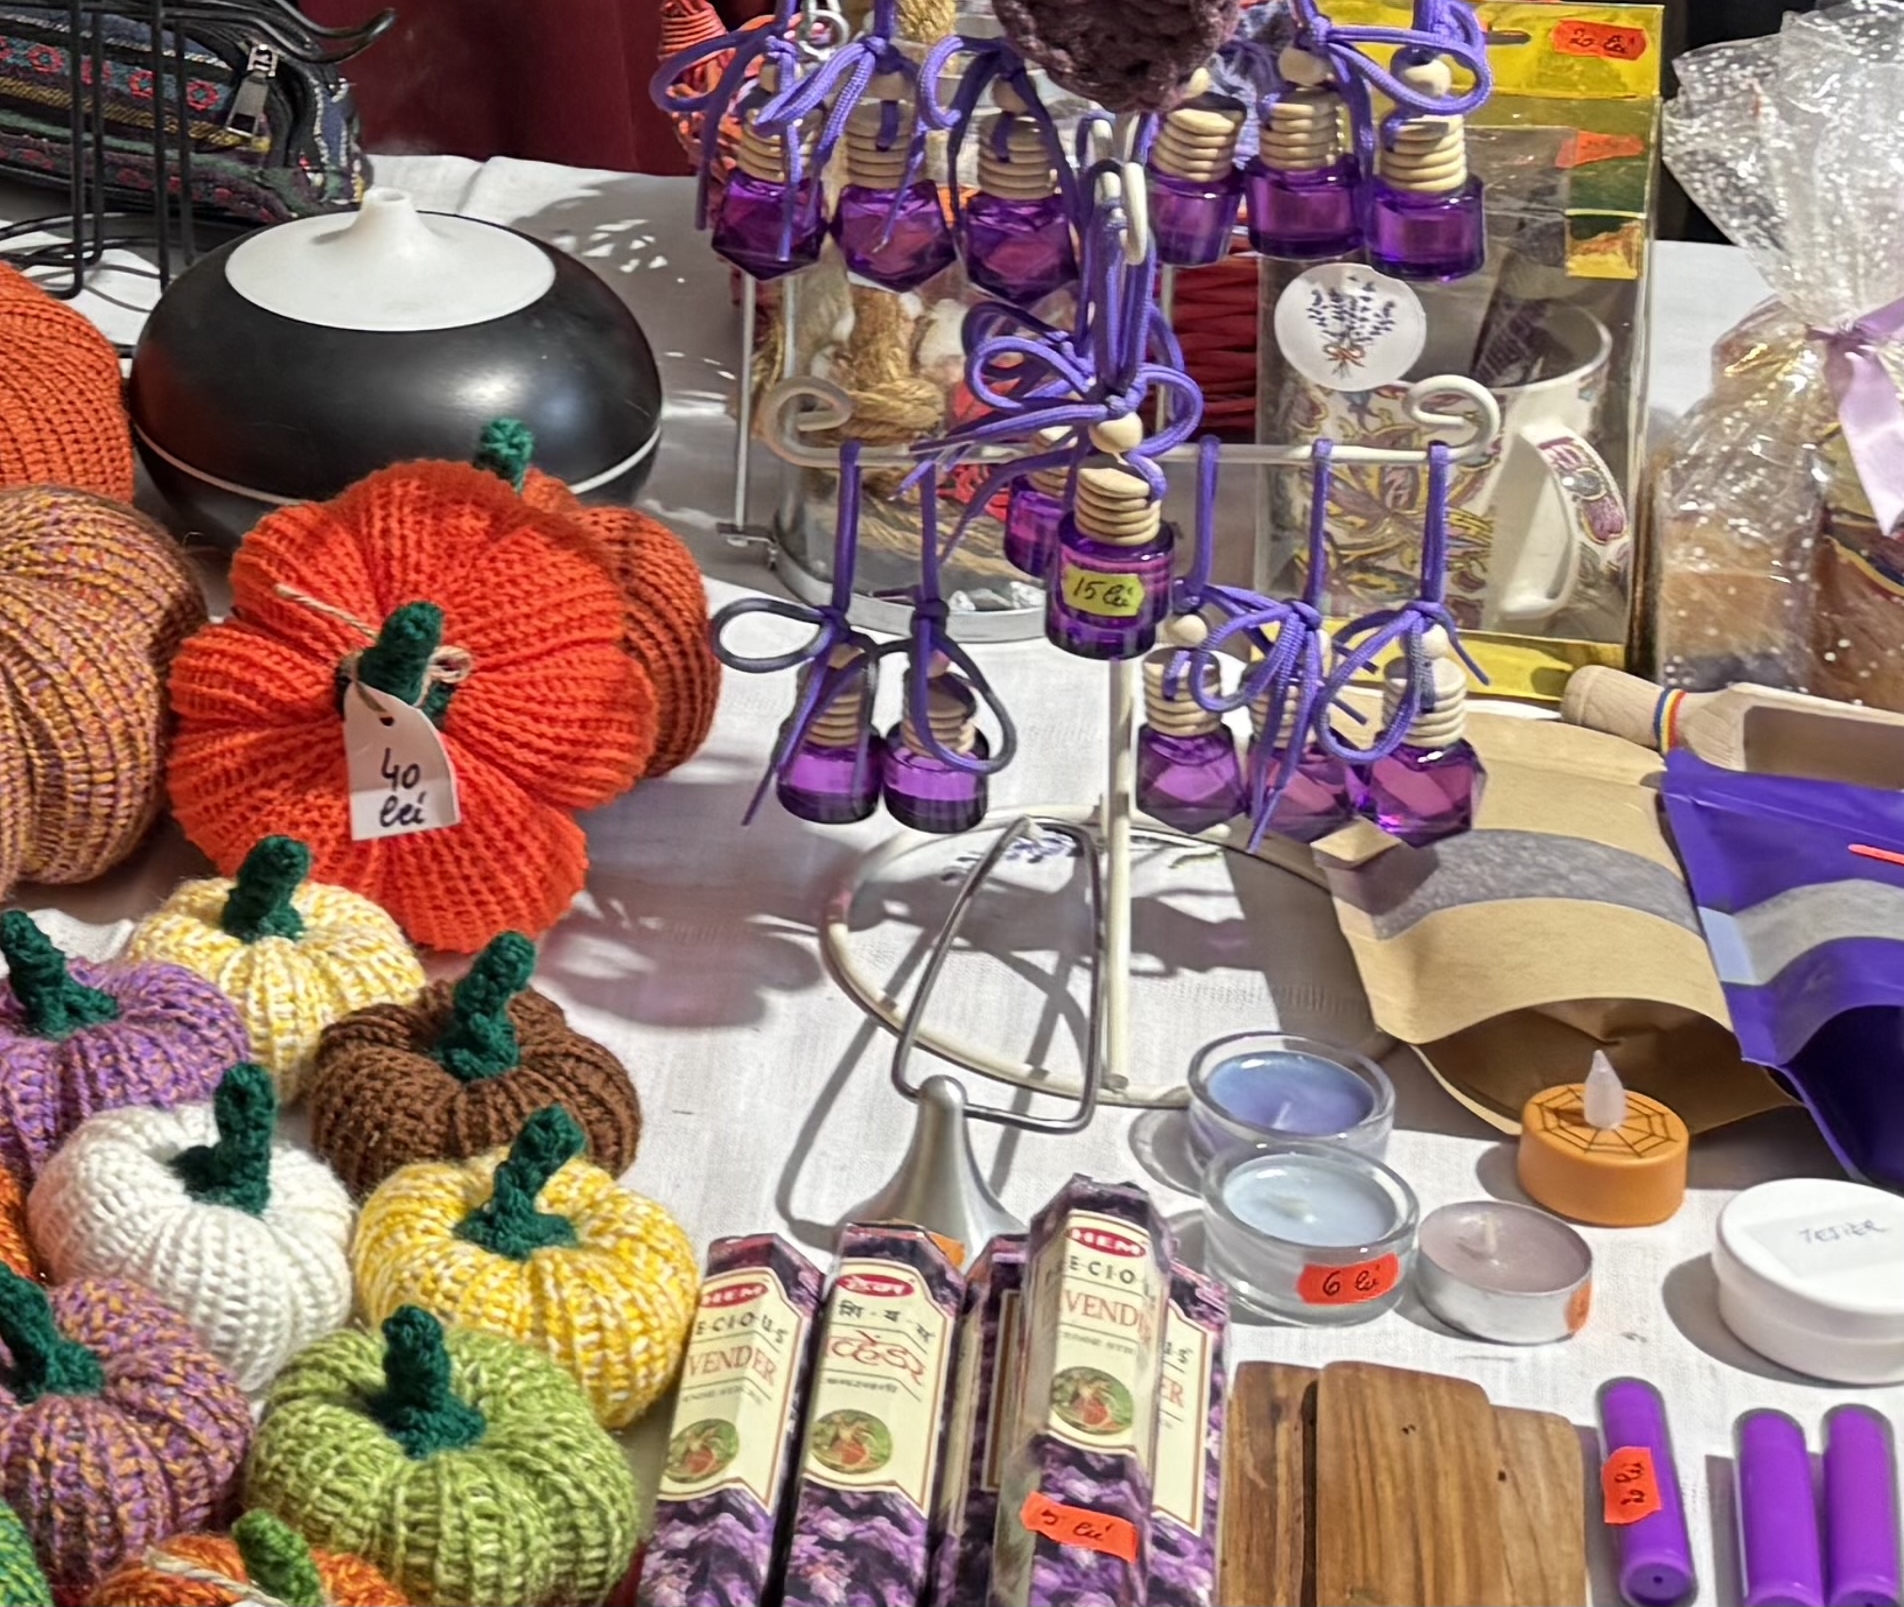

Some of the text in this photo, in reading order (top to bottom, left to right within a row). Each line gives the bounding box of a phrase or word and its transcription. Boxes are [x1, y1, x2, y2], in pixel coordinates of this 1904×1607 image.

[1073, 577, 1107, 600] 15
[380, 746, 421, 792] 40
[379, 790, 427, 828] lei
[1070, 1228, 1142, 1256] HEM
[1322, 1263, 1381, 1297] 6 lei
